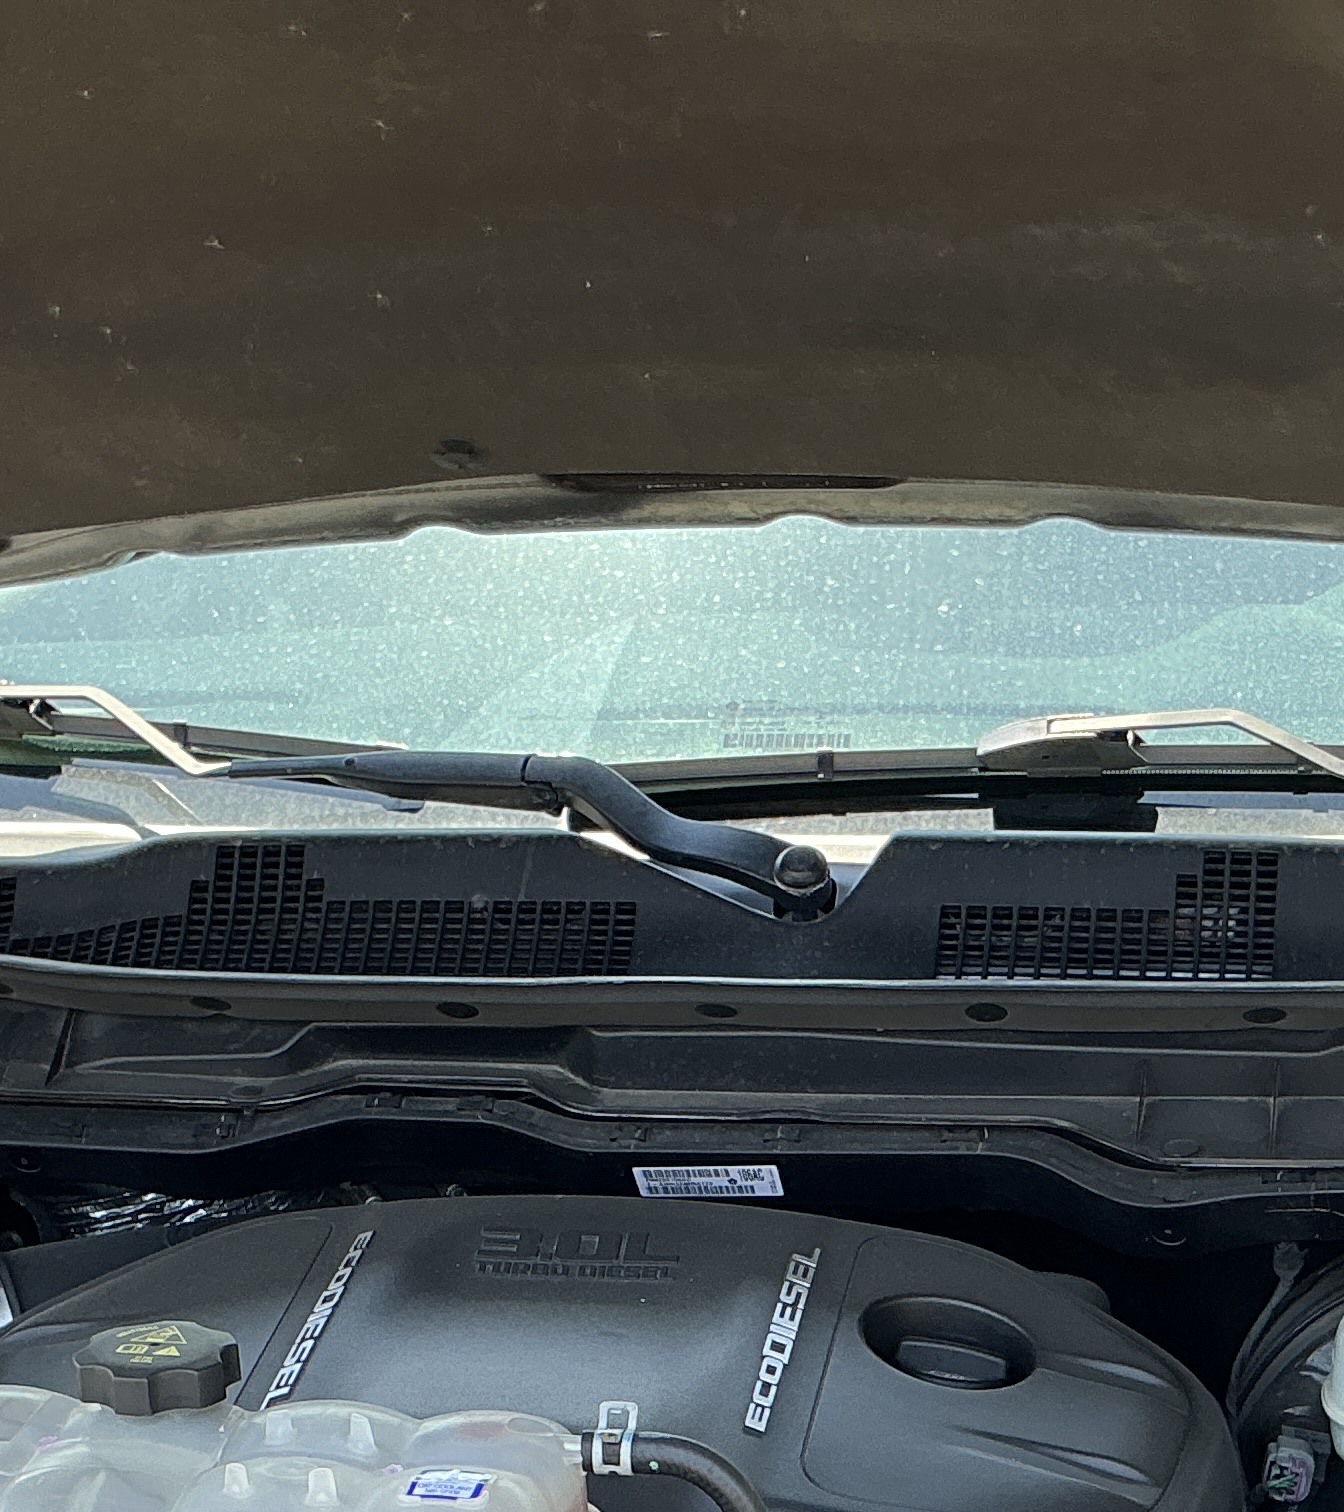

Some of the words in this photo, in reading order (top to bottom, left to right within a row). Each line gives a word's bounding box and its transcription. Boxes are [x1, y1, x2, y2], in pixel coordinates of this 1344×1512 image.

[259, 1230, 375, 1411] ECODIESEL
[475, 1227, 681, 1264] 3.0L
[744, 1247, 823, 1432] ECODIESEL
